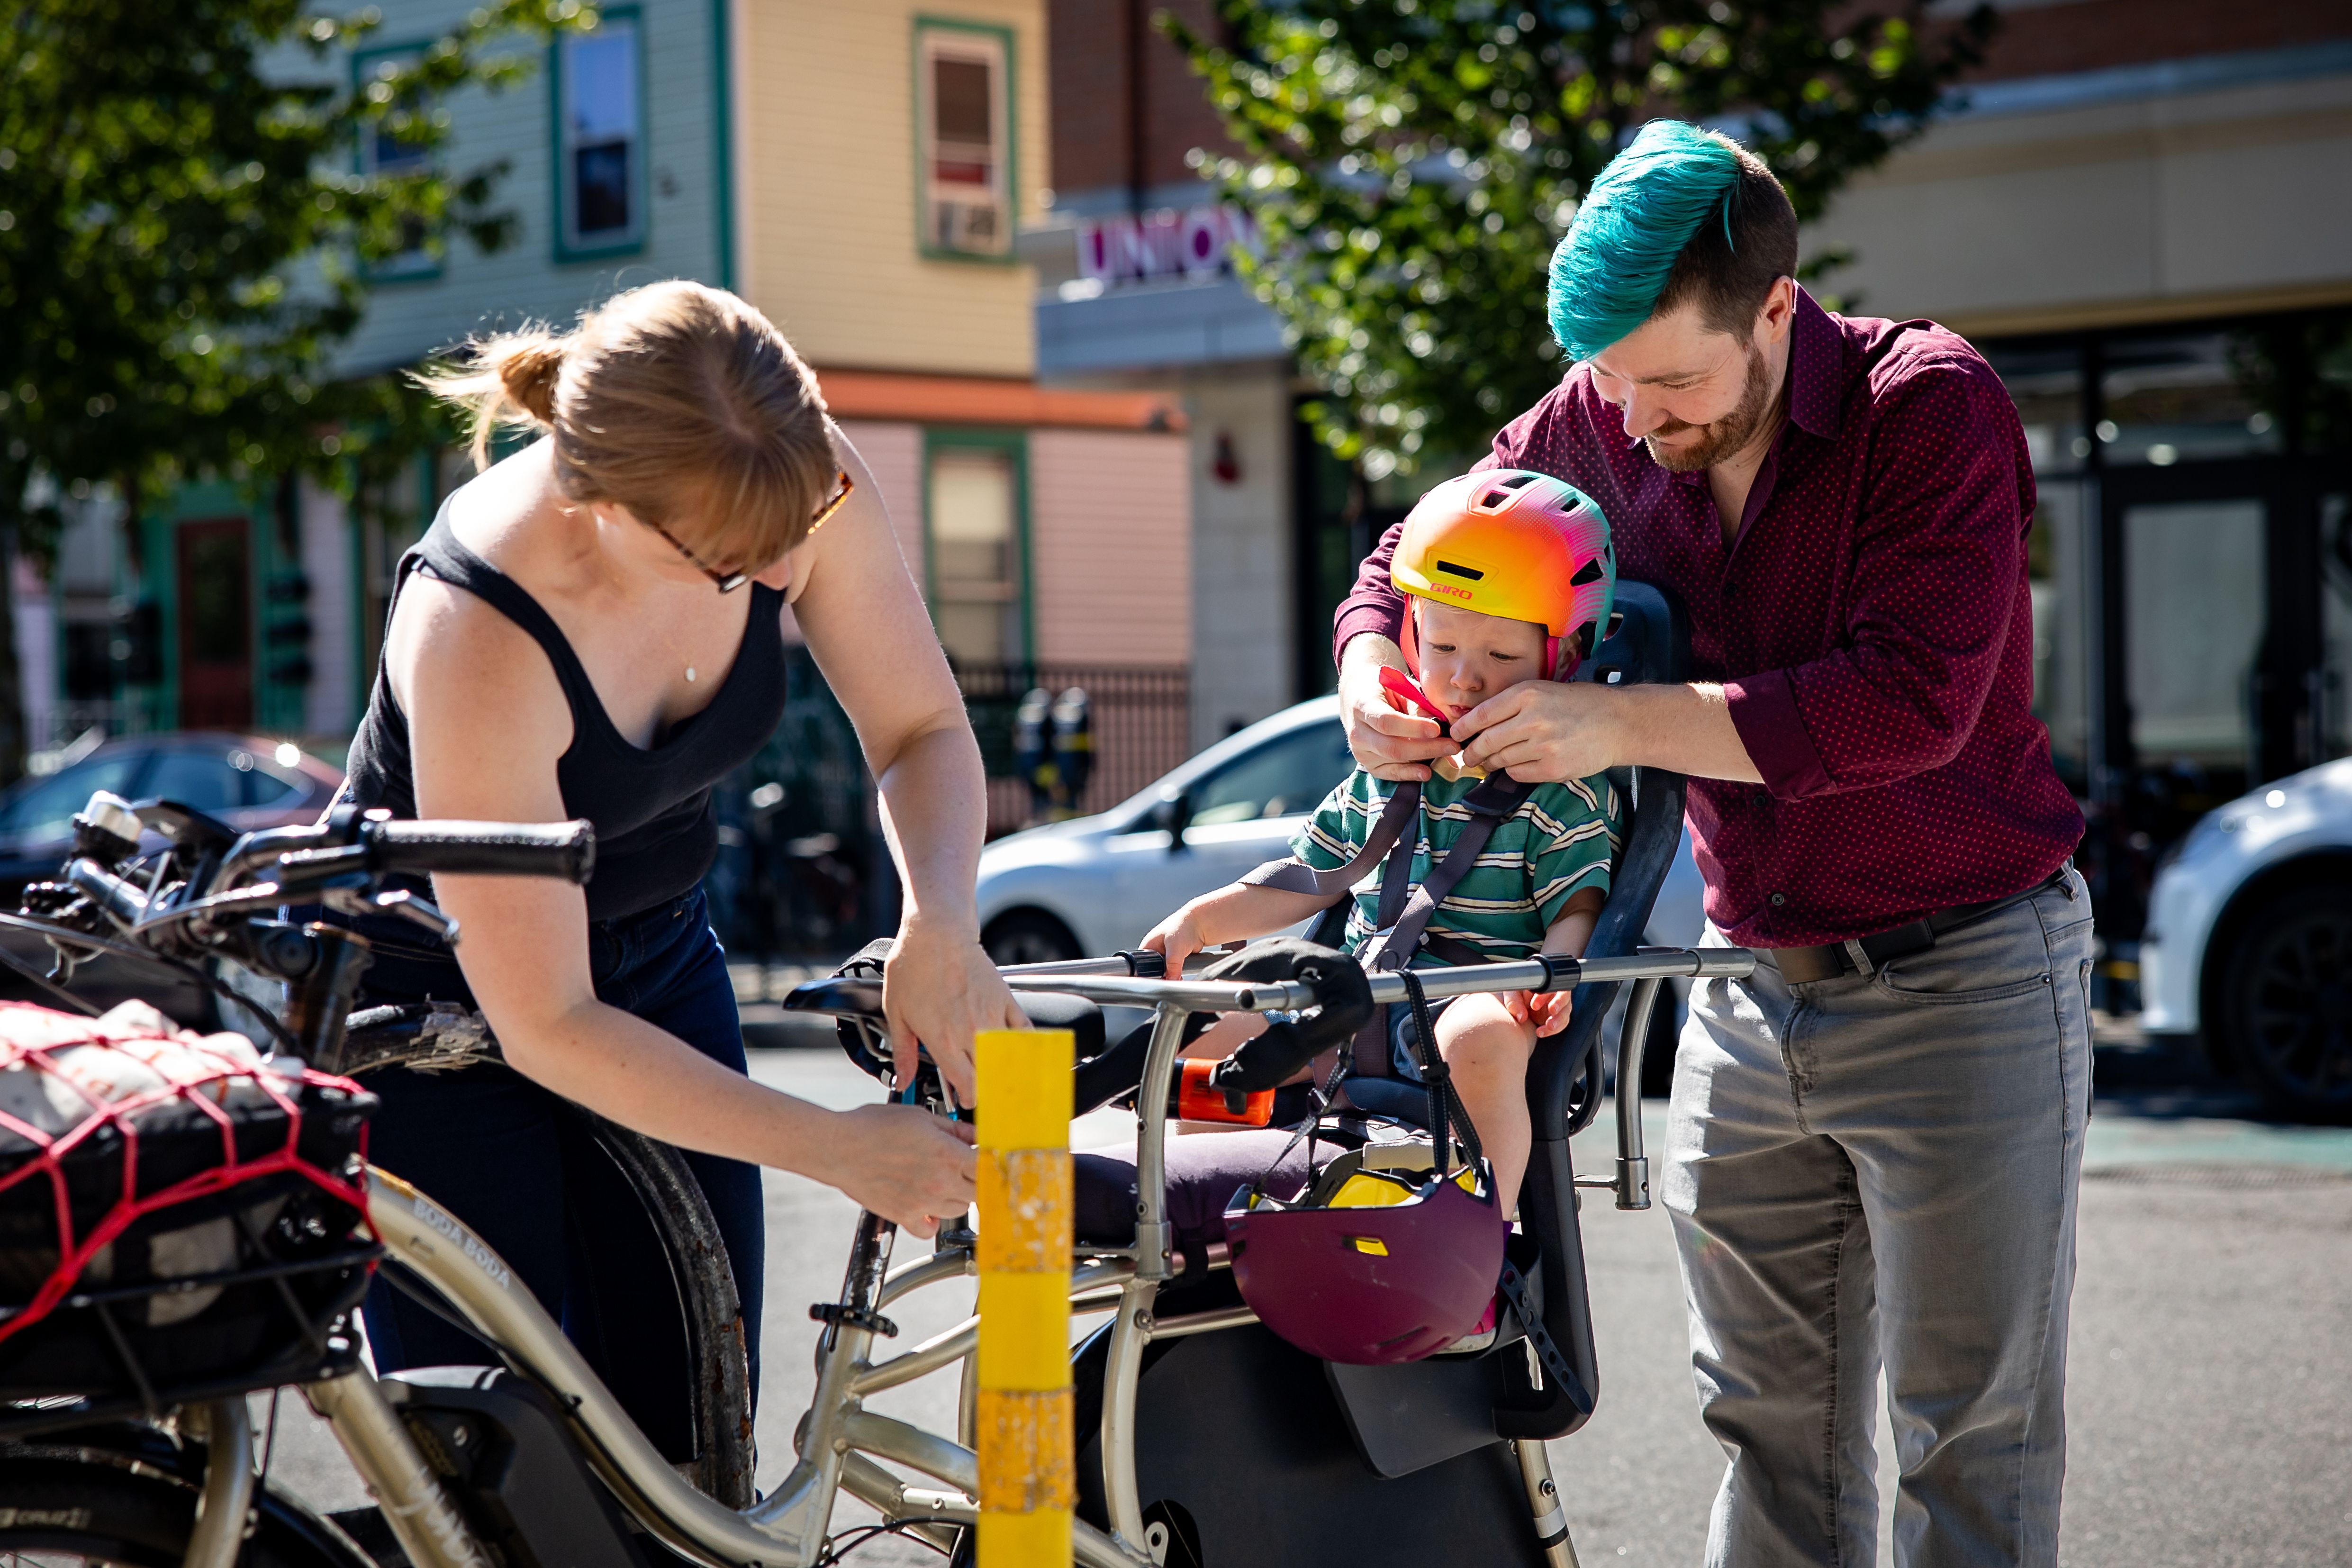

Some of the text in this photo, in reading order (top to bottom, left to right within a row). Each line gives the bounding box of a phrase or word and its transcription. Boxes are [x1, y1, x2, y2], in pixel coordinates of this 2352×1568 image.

[1429, 582, 1473, 600] GIRO
[414, 1198, 509, 1289] BODA BODA
